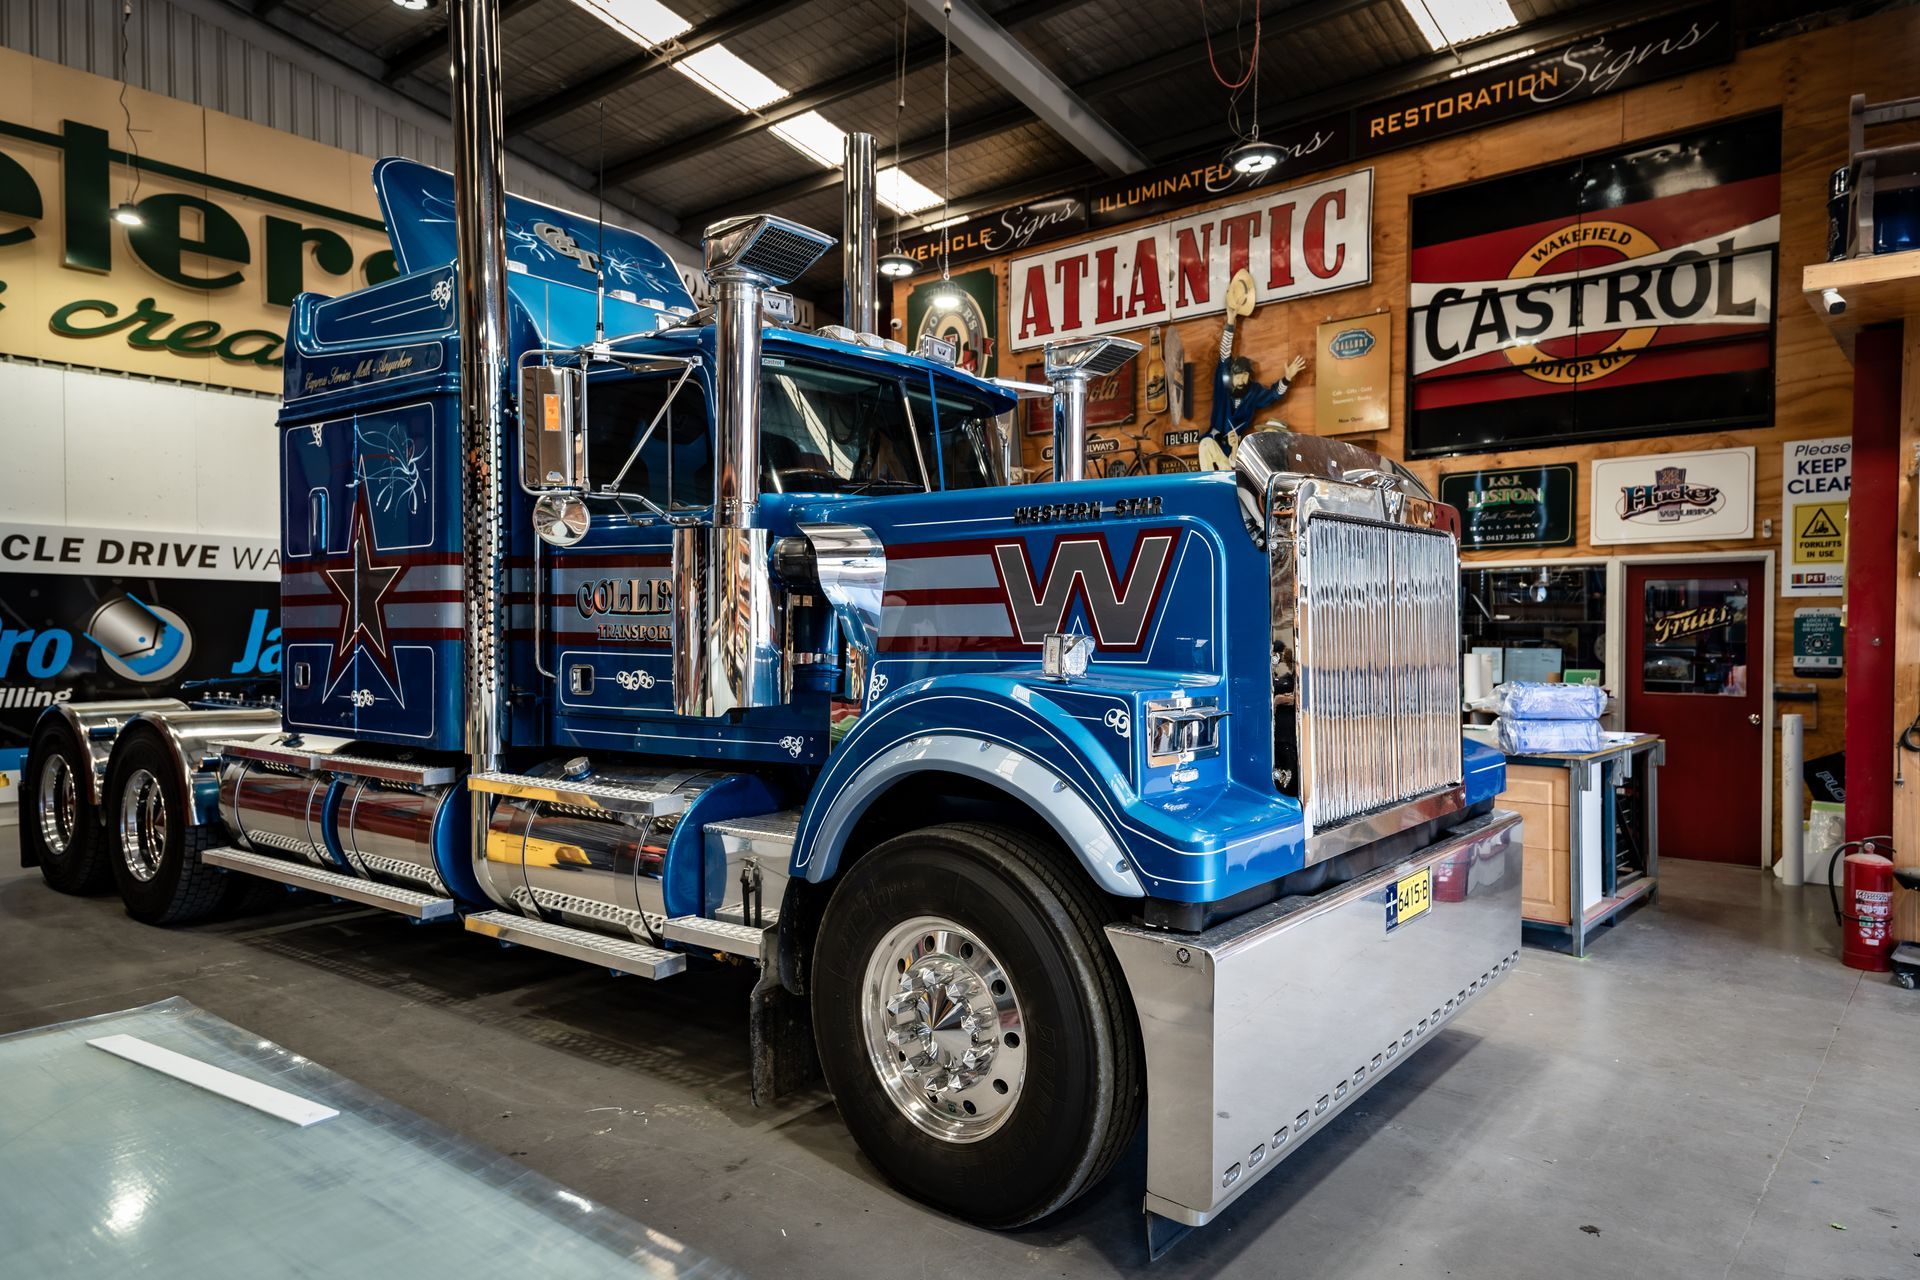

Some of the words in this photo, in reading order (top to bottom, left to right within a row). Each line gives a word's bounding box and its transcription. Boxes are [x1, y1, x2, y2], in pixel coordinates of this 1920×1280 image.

[1370, 67, 1558, 138] RESTORATION
[1530, 21, 1720, 103] Signs
[1100, 163, 1232, 213] ILLUMINATED
[904, 228, 992, 261] VEHICLE
[985, 202, 1081, 251] Signs
[1530, 226, 1632, 263] WAKEFIELD
[1019, 188, 1347, 340] ATLANTIC
[1425, 236, 1757, 362] CASTROL
[1087, 441, 1115, 453] ILWAYS
[1794, 443, 1851, 456] Please
[1797, 457, 1847, 475] KEEP
[1014, 502, 1102, 524] WESTERN
[1115, 496, 1163, 516] STAR
[1467, 487, 1544, 511] LISTON
[97, 539, 220, 569] DRIVE
[1799, 541, 1842, 549] FORKLIFTS
[1819, 550, 1834, 558] USE
[996, 530, 1178, 648] W
[0, 627, 73, 679] ro
